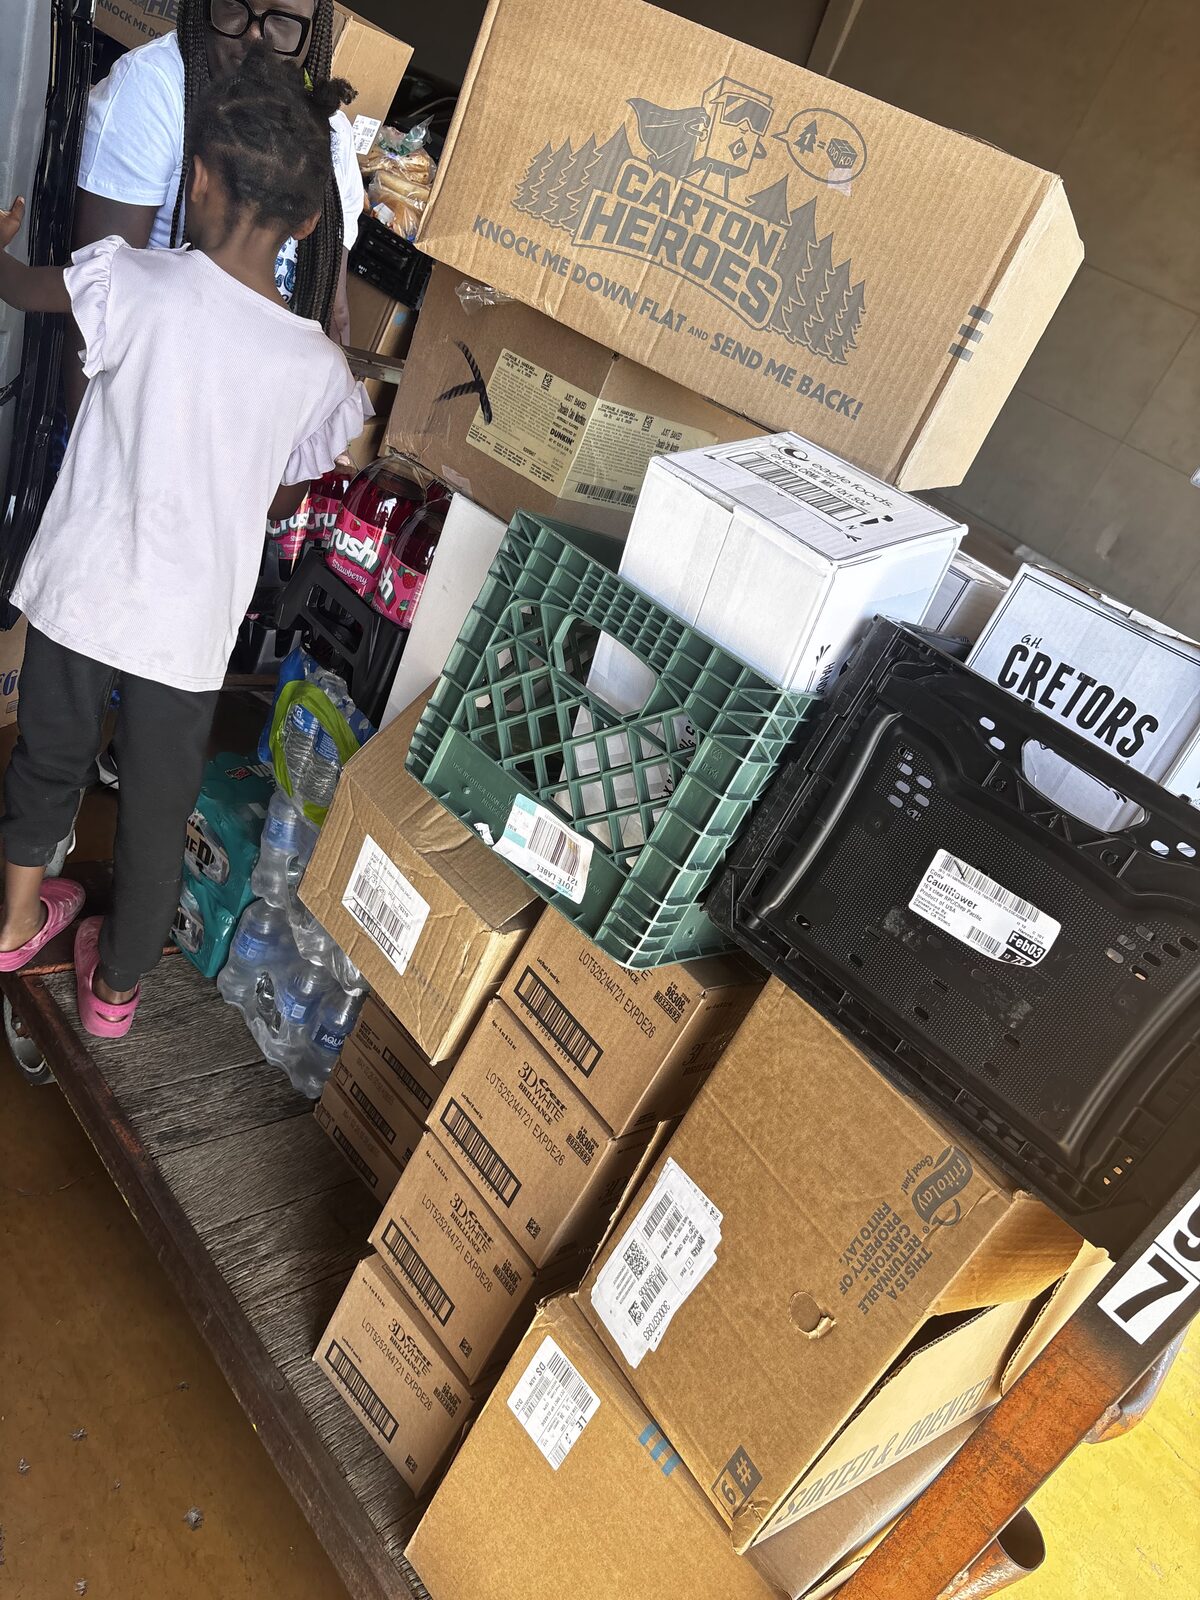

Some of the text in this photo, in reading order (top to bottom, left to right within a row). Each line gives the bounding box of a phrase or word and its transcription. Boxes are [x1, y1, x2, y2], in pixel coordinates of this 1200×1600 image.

[132, 19, 148, 33] ME
[615, 165, 783, 266] CARTON
[584, 198, 777, 324] HEROES
[473, 215, 863, 422] KNOCK ME DOWN FLAT AND SEND ME BACK!
[812, 462, 850, 484] eagle
[332, 527, 379, 570] rush
[997, 644, 1159, 758] CRETORS
[536, 864, 556, 882] LABEL
[555, 878, 574, 893] TOTE
[926, 874, 979, 911] Cauliflower
[919, 888, 939, 902] Product
[944, 903, 956, 913] USA
[931, 888, 944, 898] clear
[965, 908, 982, 921] Pacific
[1009, 932, 1045, 960] Feb03
[578, 948, 656, 1040] LOT5252144721 EXPDE26
[517, 1060, 567, 1113] 3D Crest
[517, 1081, 553, 1126] BRILLIANCE
[532, 1084, 563, 1123] WHITE
[484, 1067, 566, 1166] LOT5252144721 EXPDE26
[911, 1154, 934, 1178] Good
[916, 1157, 968, 1212] Frito Lay
[448, 1211, 483, 1255] BRILLIANCE
[449, 1192, 495, 1245] 3D Crest
[461, 1215, 490, 1253] WHITE
[858, 1200, 891, 1241] FRITO
[419, 1193, 467, 1254] LOT5252144721
[462, 1250, 495, 1293] EXPDE26
[835, 1211, 901, 1295] PROPERTY OF
[866, 1222, 911, 1279] CARTON
[856, 1232, 922, 1316] RETURNABLE
[886, 1244, 932, 1301] THIS IS A
[359, 1317, 405, 1376] LOT5252144721
[402, 1371, 434, 1411] EXPDE26
[387, 1317, 433, 1368] 3D Crest
[388, 1335, 422, 1377] BRILLIANCE
[400, 1339, 430, 1377] WHITE
[534, 1361, 545, 1376] DS
[777, 1375, 994, 1526] SORTED & ORIENTED
